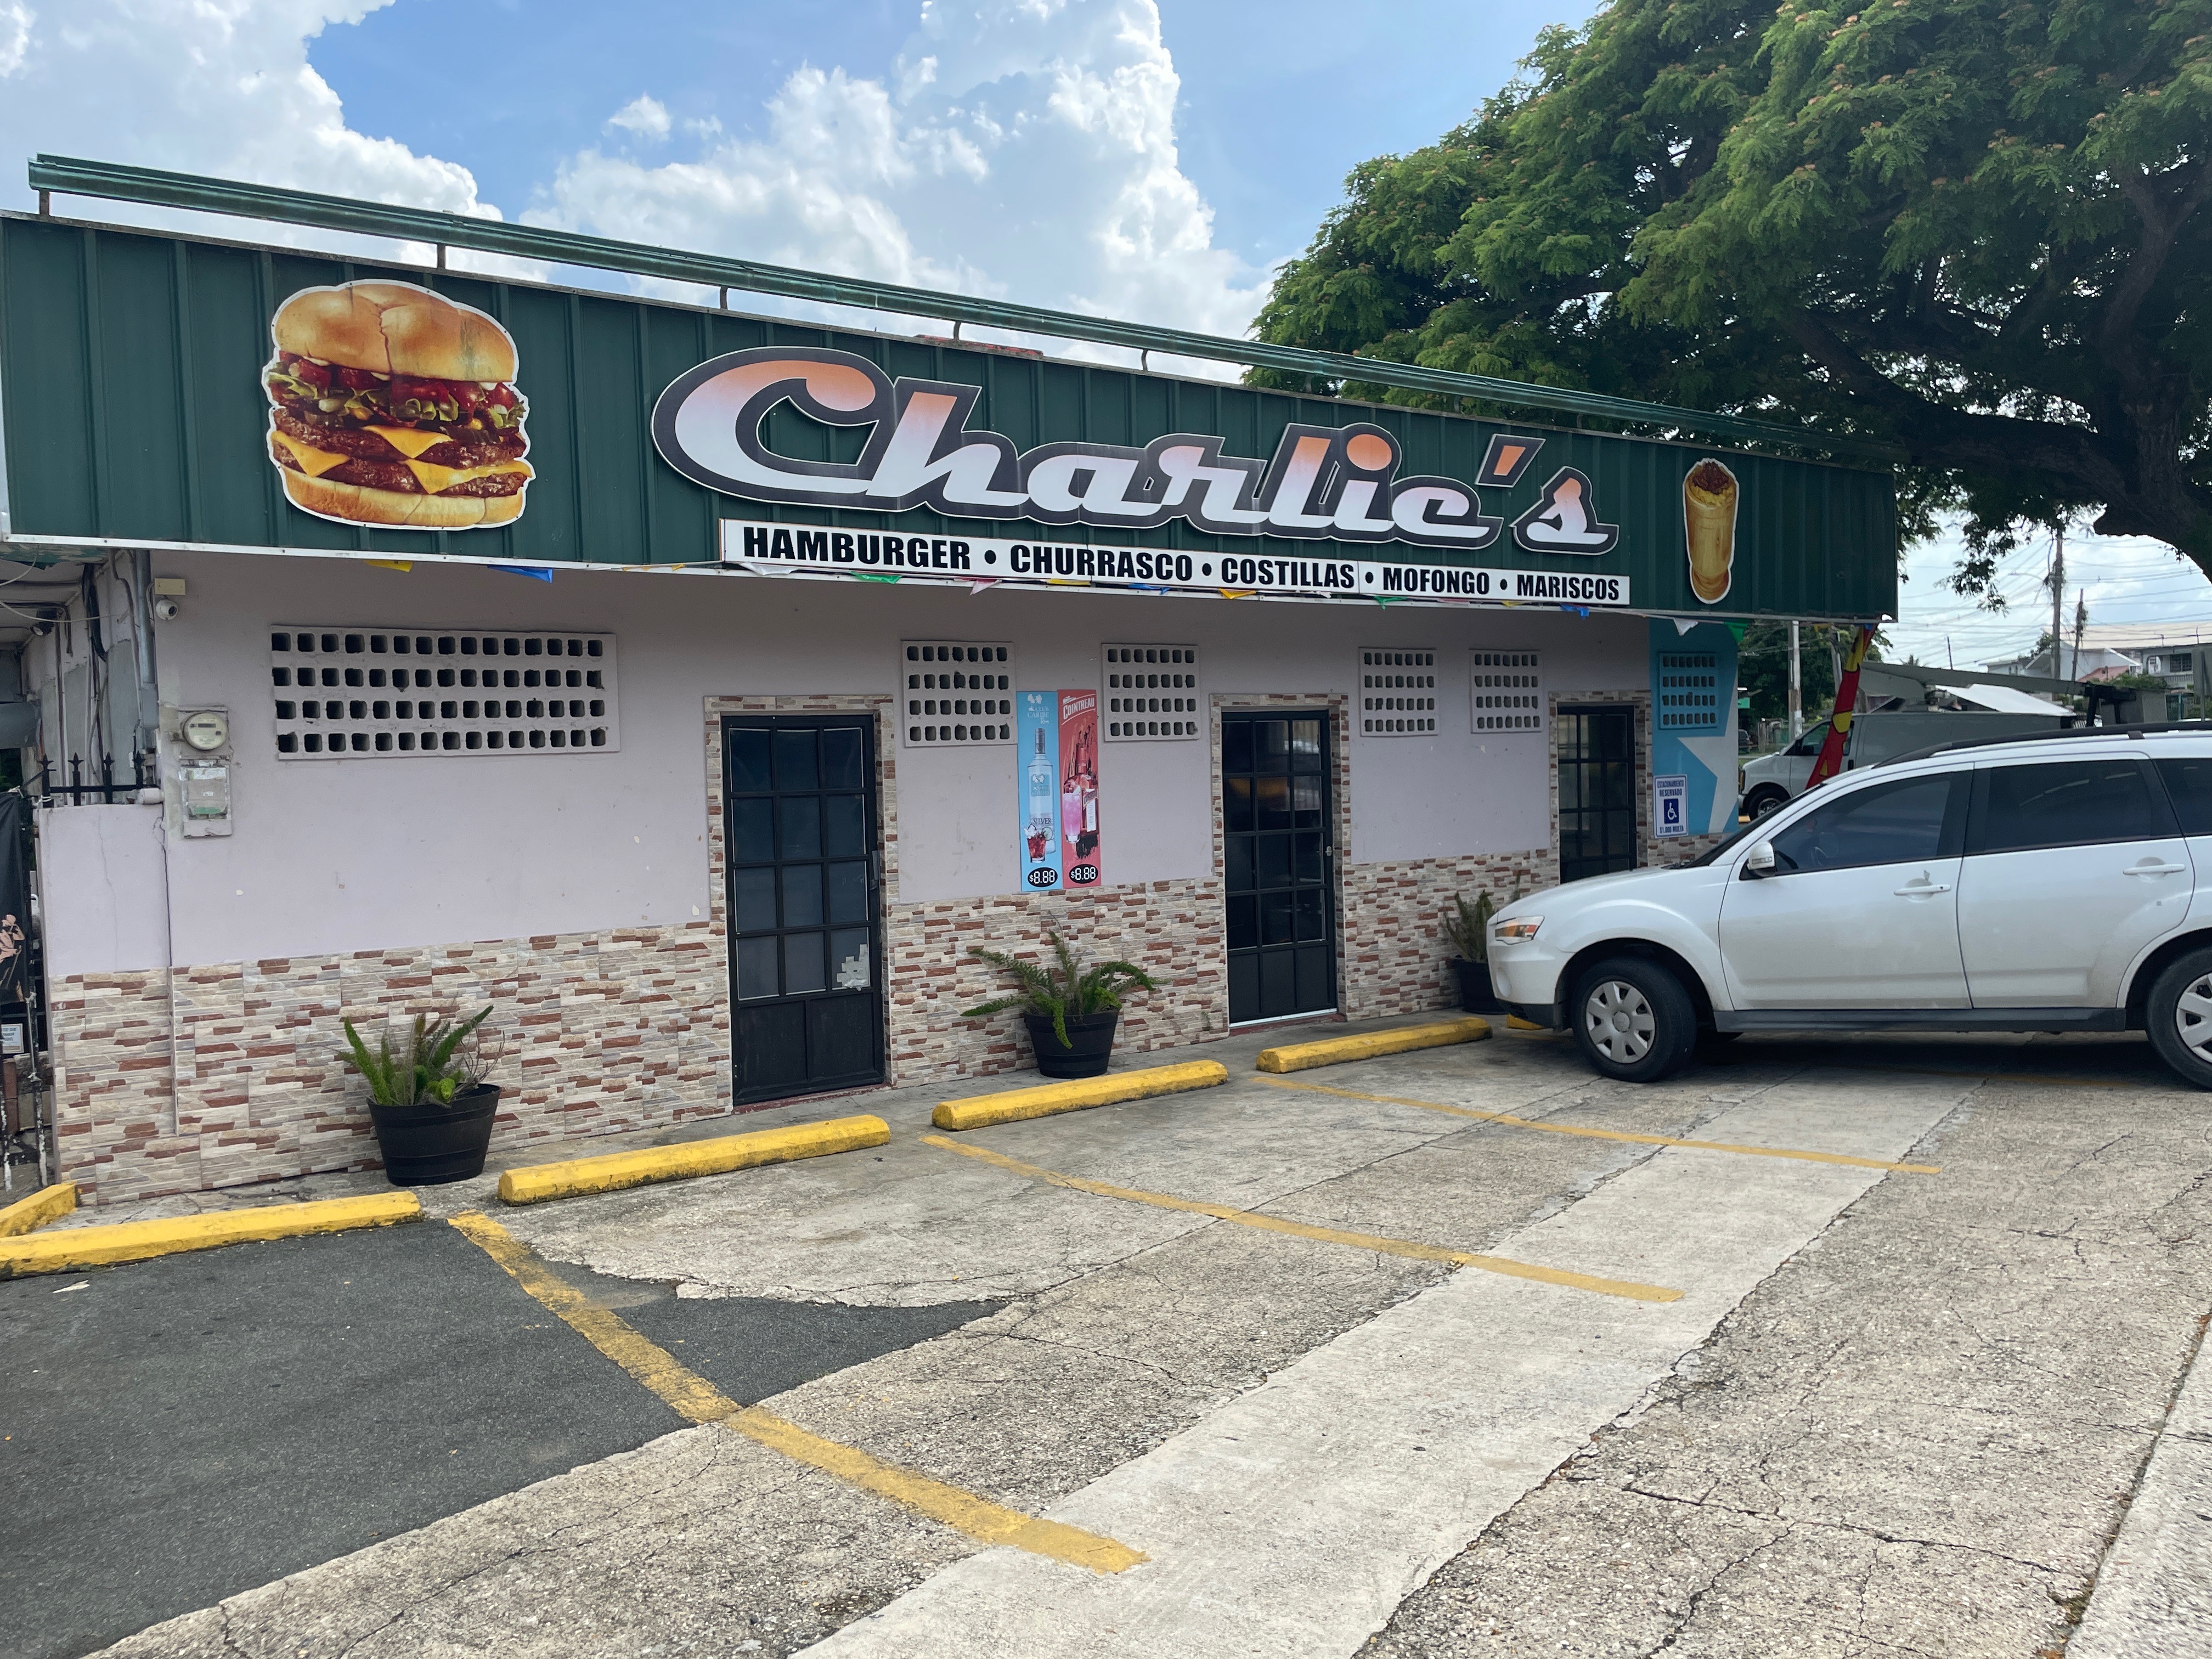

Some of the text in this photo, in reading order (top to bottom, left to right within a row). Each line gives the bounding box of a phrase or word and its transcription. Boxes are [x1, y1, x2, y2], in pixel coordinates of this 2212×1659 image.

[674, 359, 1609, 545] Charlie's
[743, 526, 1620, 600] HAMBURGER CHURRASCO COSTILLAS MOFONGO MARISCOS
[1063, 697, 1094, 720] COINTREAU
[1660, 788, 1682, 797] RESERVADO
[1029, 870, 1055, 884] $8.88
[1071, 866, 1096, 881] $8.88
